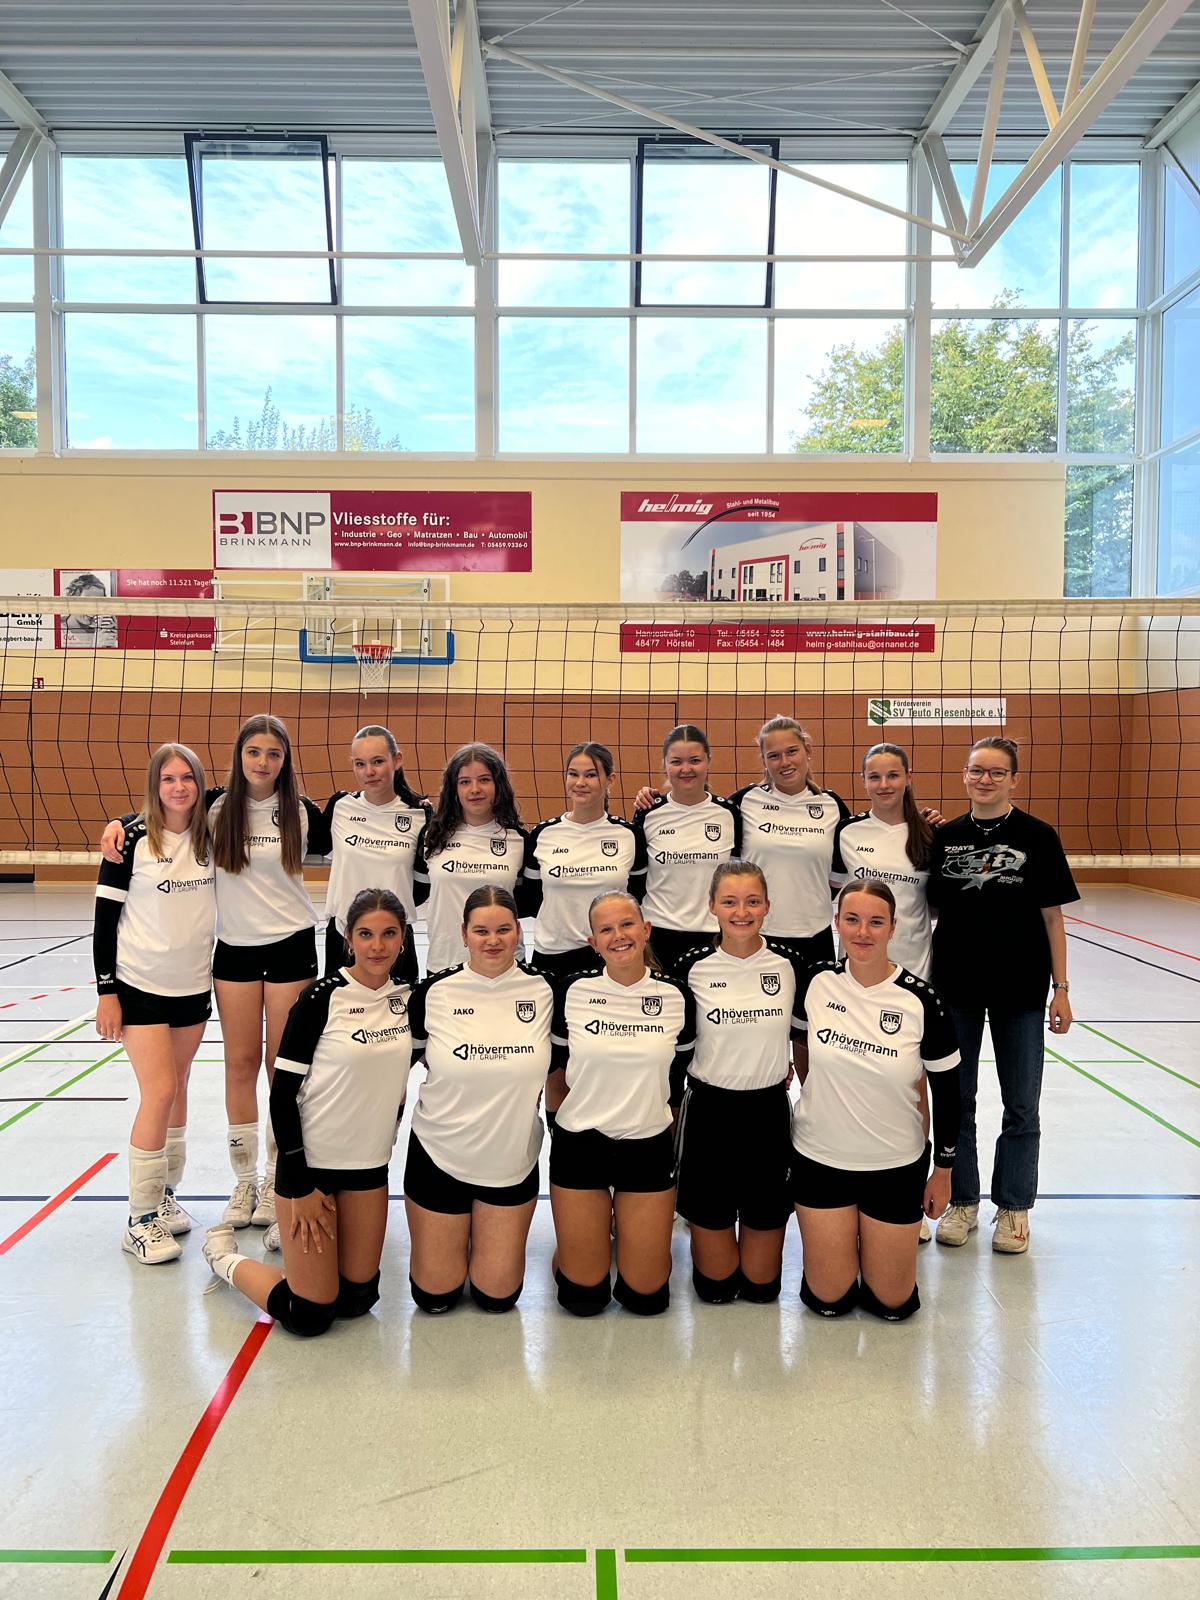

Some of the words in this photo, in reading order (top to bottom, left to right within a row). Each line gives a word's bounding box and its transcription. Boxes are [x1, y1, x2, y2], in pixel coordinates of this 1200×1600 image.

[638, 494, 713, 515] helmig
[256, 511, 326, 535] BNP
[333, 512, 417, 526] Vliesstoffe
[423, 512, 450, 526] für:
[341, 530, 376, 538] Industrie
[387, 530, 402, 538] Geo
[413, 531, 453, 539] Matratzen
[463, 531, 478, 539] Bau
[488, 531, 528, 539] Automobil
[220, 538, 311, 546] BRINKMANN
[635, 639, 660, 647] 48477
[666, 639, 695, 647] Hörstel
[893, 708, 905, 717] SV
[908, 708, 931, 717] Teuto
[934, 708, 985, 717] Resenbeck
[772, 823, 825, 835] hövermann
[358, 836, 410, 849] hövermann
[667, 851, 719, 860] hövermann
[455, 860, 510, 872] hövermann
[562, 865, 618, 873] hövermann
[865, 867, 920, 885] hövermann
[826, 1001, 847, 1013] JAKO
[722, 1008, 784, 1019] hövermann
[601, 1020, 664, 1033] hövermann
[470, 1044, 534, 1054] hövermann
[831, 1030, 899, 1058] hövermann
